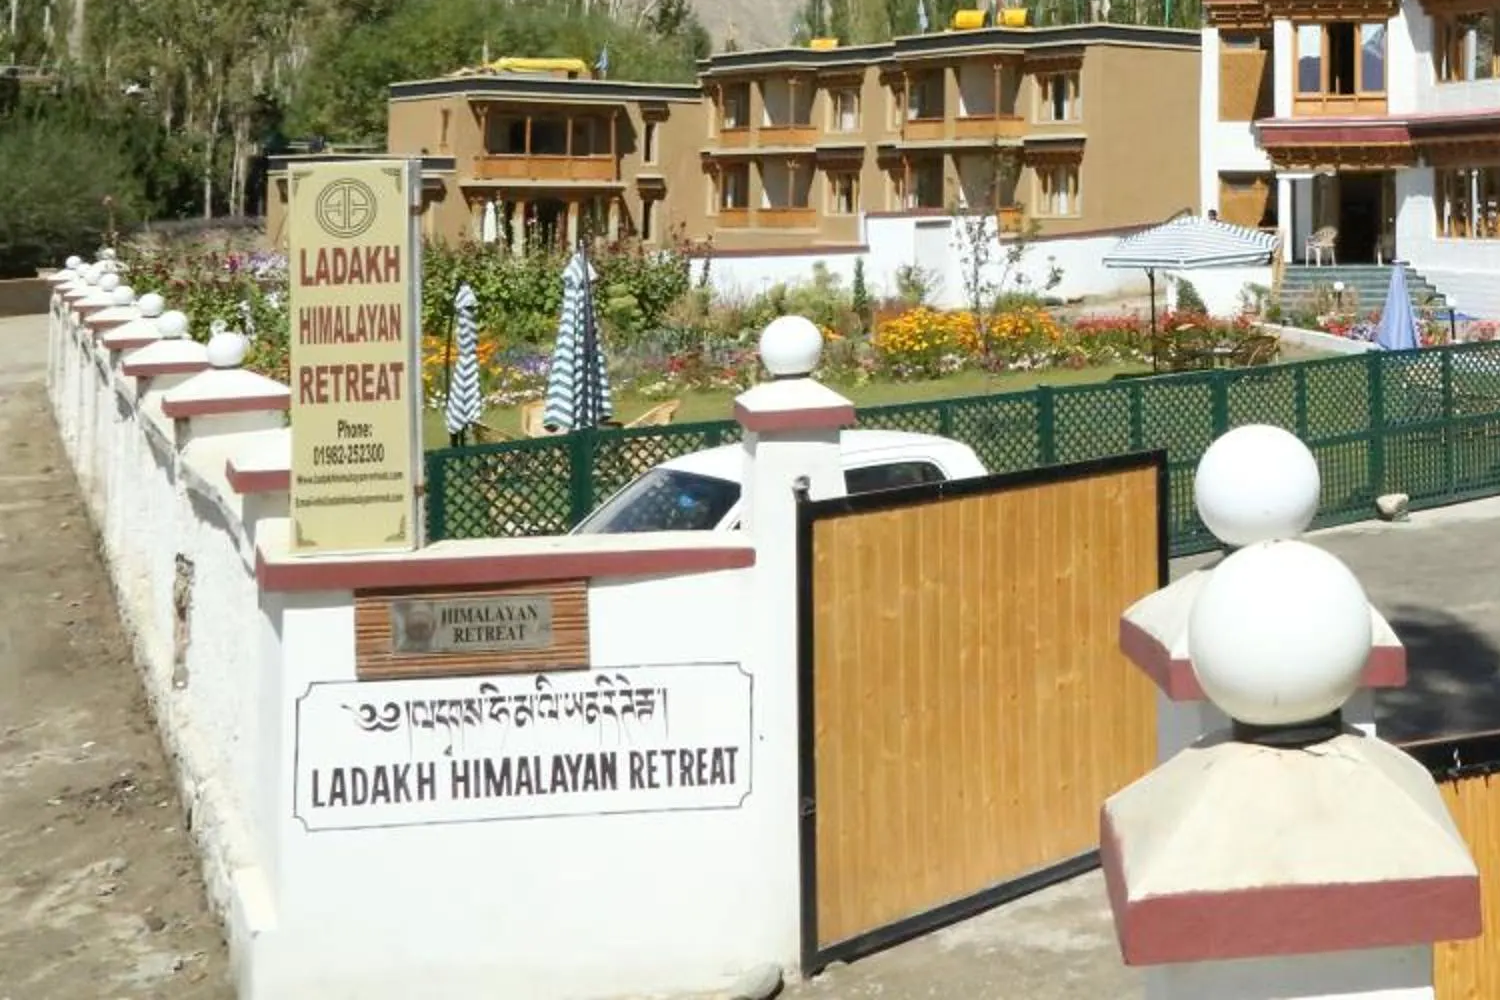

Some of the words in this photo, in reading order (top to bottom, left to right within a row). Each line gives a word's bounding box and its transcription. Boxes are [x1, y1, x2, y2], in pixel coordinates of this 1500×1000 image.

[301, 245, 400, 286] LADAKH
[300, 304, 402, 344] HIMALAYAN
[300, 362, 404, 404] RETREAT
[337, 418, 373, 439] Phone:
[313, 442, 385, 467] 01982-252300
[441, 603, 538, 625] HIMALAYAN
[453, 624, 526, 643] RETREAT
[312, 761, 436, 807] LADAKH
[451, 752, 617, 799] HIMALAYAN
[629, 746, 739, 790] RETREAT
